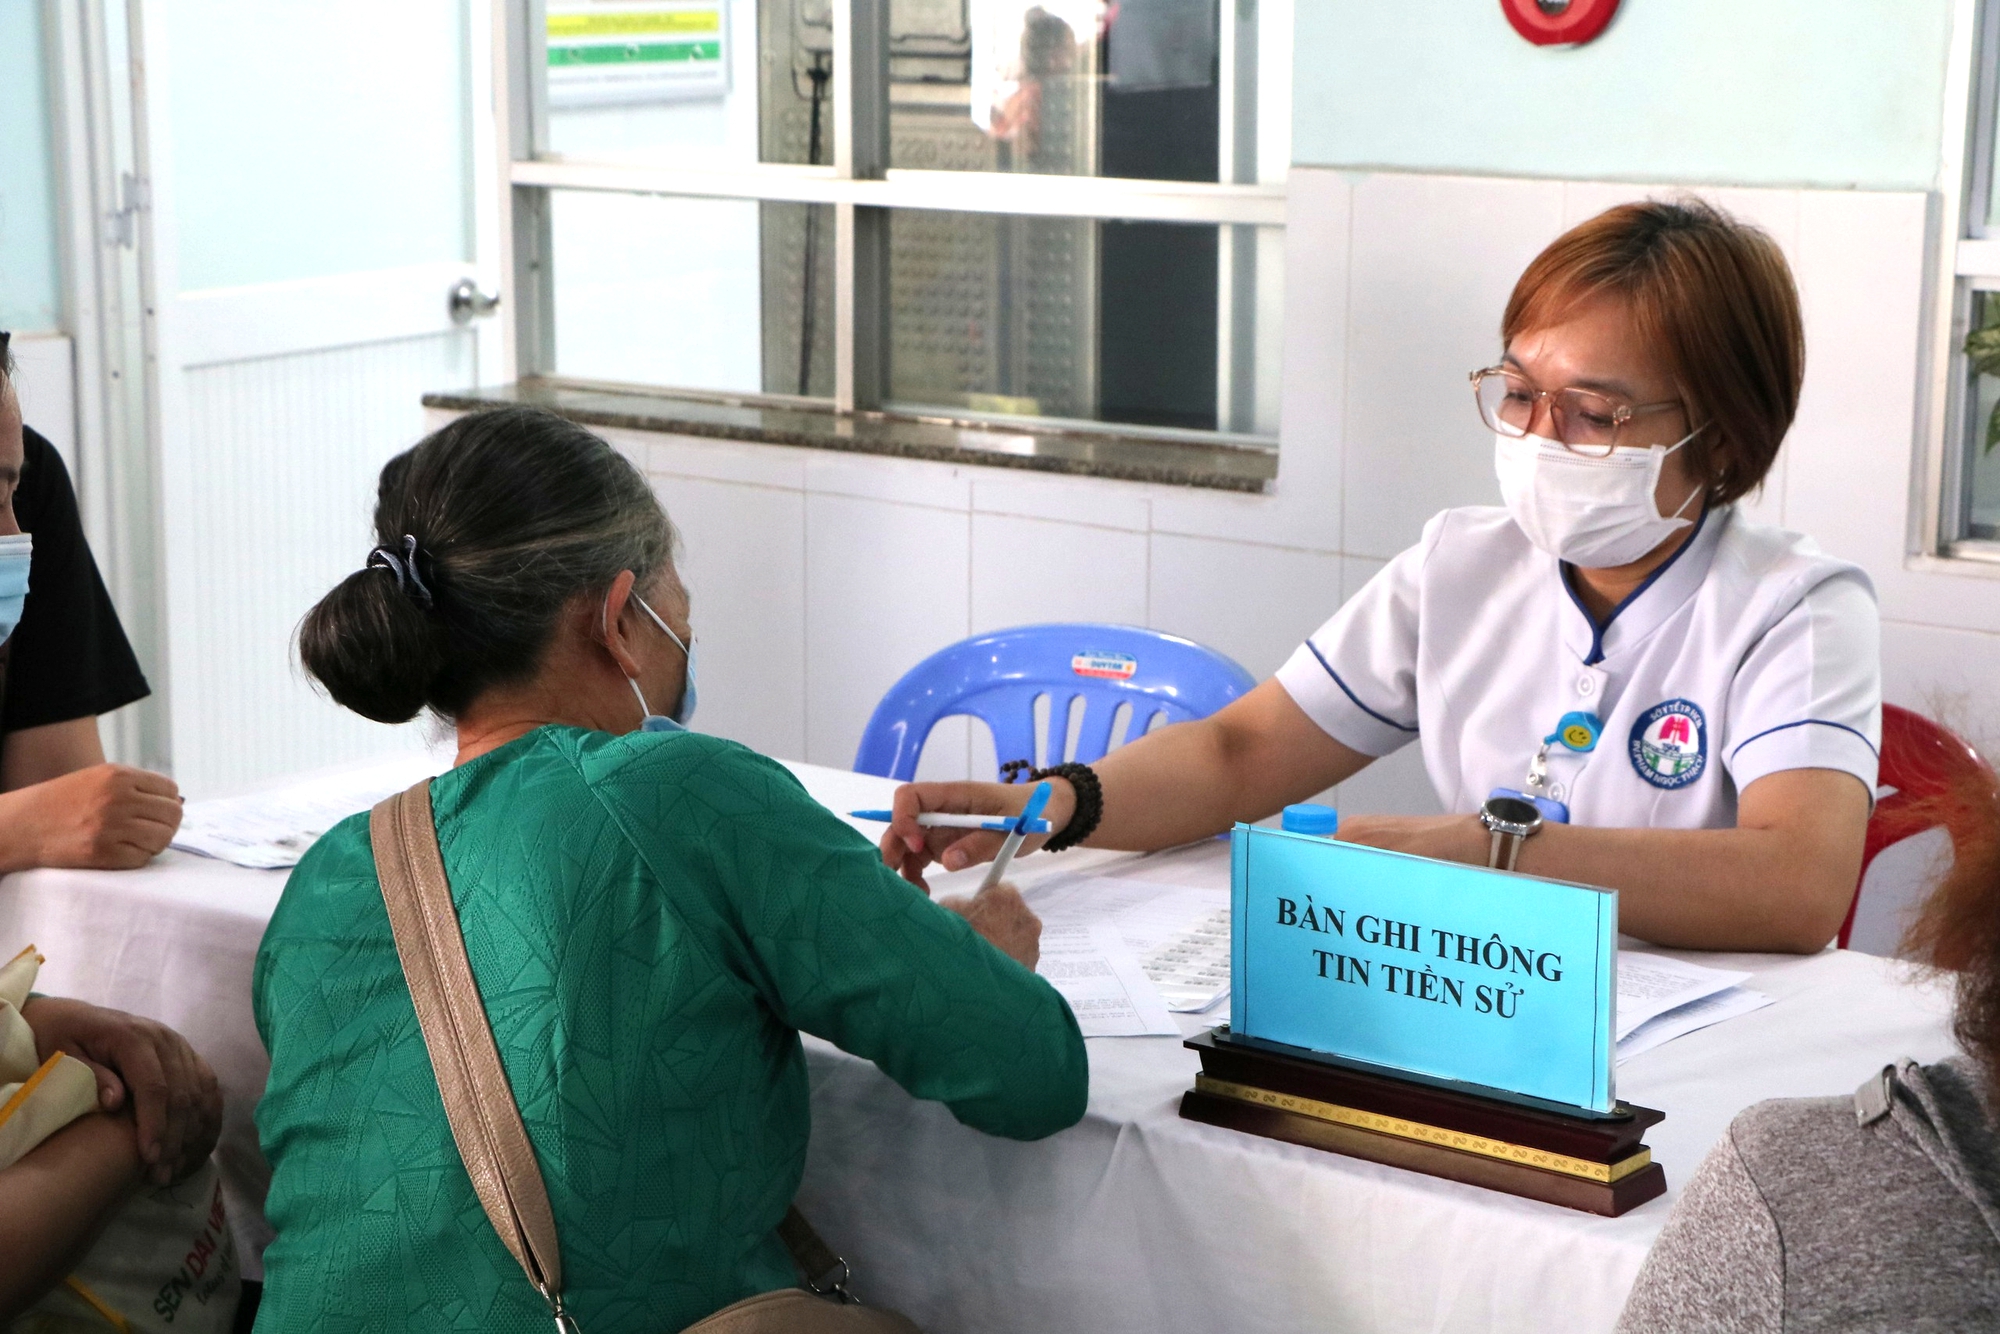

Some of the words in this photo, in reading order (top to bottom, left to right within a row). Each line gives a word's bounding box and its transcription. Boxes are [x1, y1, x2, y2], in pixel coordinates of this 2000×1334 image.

[1276, 894, 1346, 937] BÀN
[1356, 915, 1421, 953] GHI
[1431, 929, 1563, 982] THÔNG
[1312, 949, 1371, 987] TIN
[1381, 963, 1465, 1008] TIỀN
[1474, 981, 1525, 1019] SỬ
[153, 1266, 193, 1324] SEN
